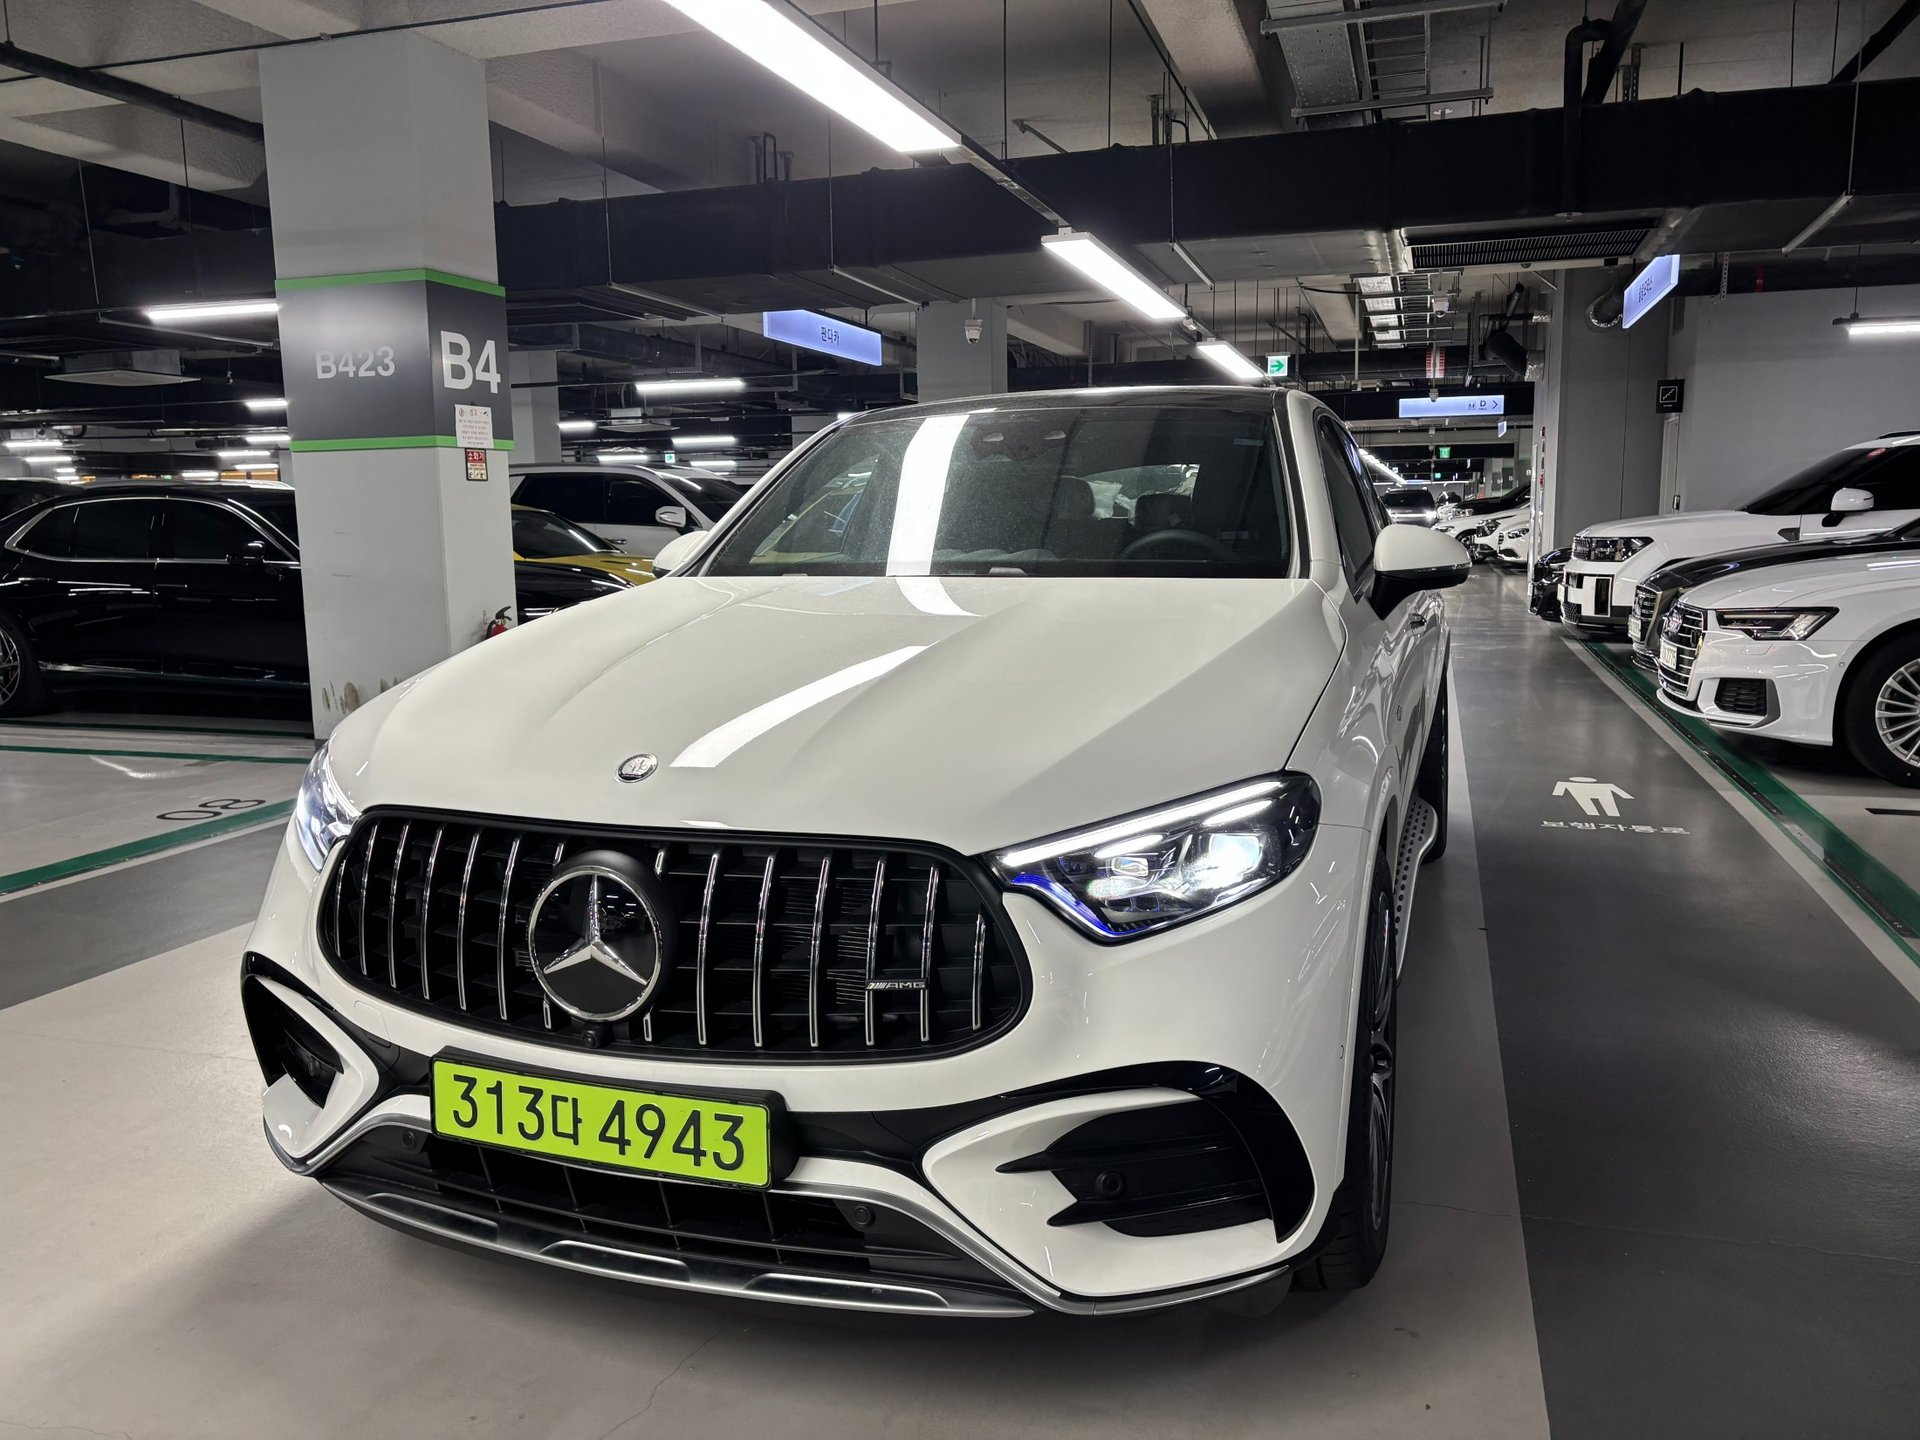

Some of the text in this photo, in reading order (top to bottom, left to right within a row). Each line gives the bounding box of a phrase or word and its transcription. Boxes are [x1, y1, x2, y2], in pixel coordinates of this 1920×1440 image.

[315, 345, 396, 379] B423
[440, 330, 501, 394] B4
[156, 799, 266, 820] 08
[1540, 820, 1691, 835] 보행자통로
[886, 981, 926, 989] AMG
[453, 1074, 745, 1171] 313다 4943
